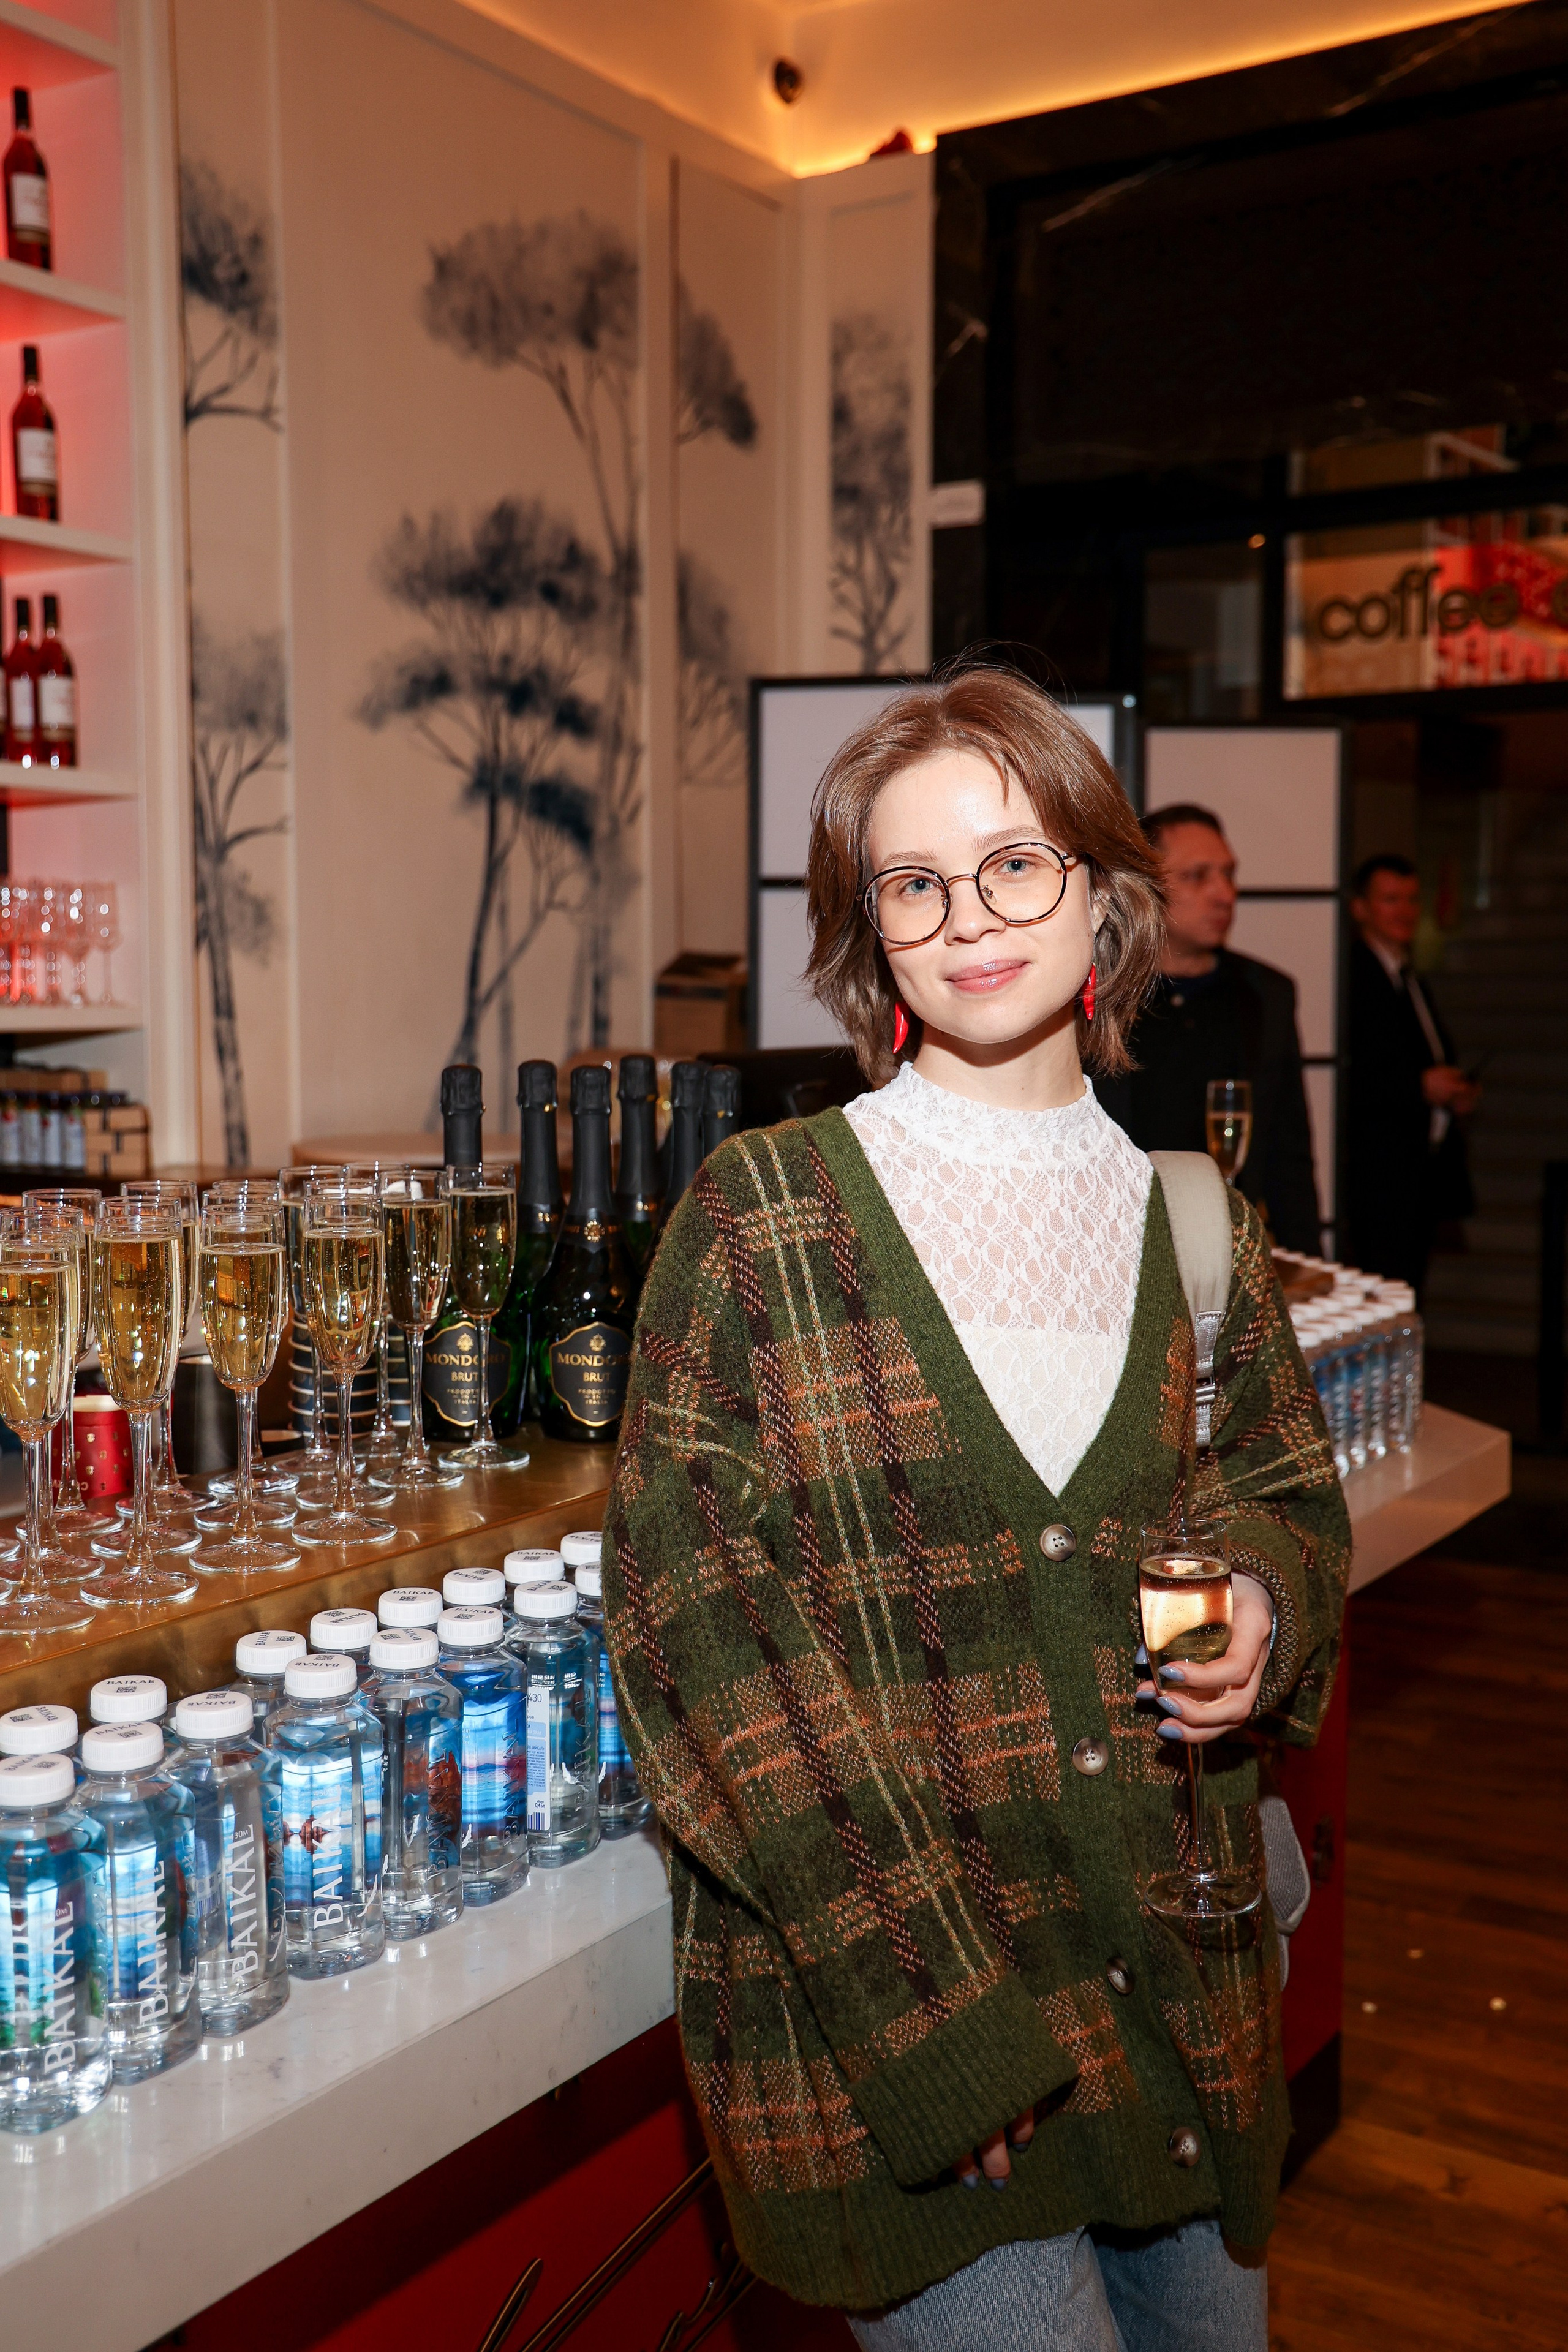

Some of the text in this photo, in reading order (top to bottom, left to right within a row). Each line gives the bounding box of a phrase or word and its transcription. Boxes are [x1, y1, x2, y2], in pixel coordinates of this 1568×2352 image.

[1317, 564, 1520, 642] coffee
[451, 1371, 478, 1382] BRUT
[582, 1371, 611, 1382] BRUT
[227, 1823, 259, 1980] BAIKAL
[311, 1784, 344, 1930] BAIKAL
[43, 1901, 76, 2075] BAIKAL
[135, 1860, 169, 2026] BAIKAL
